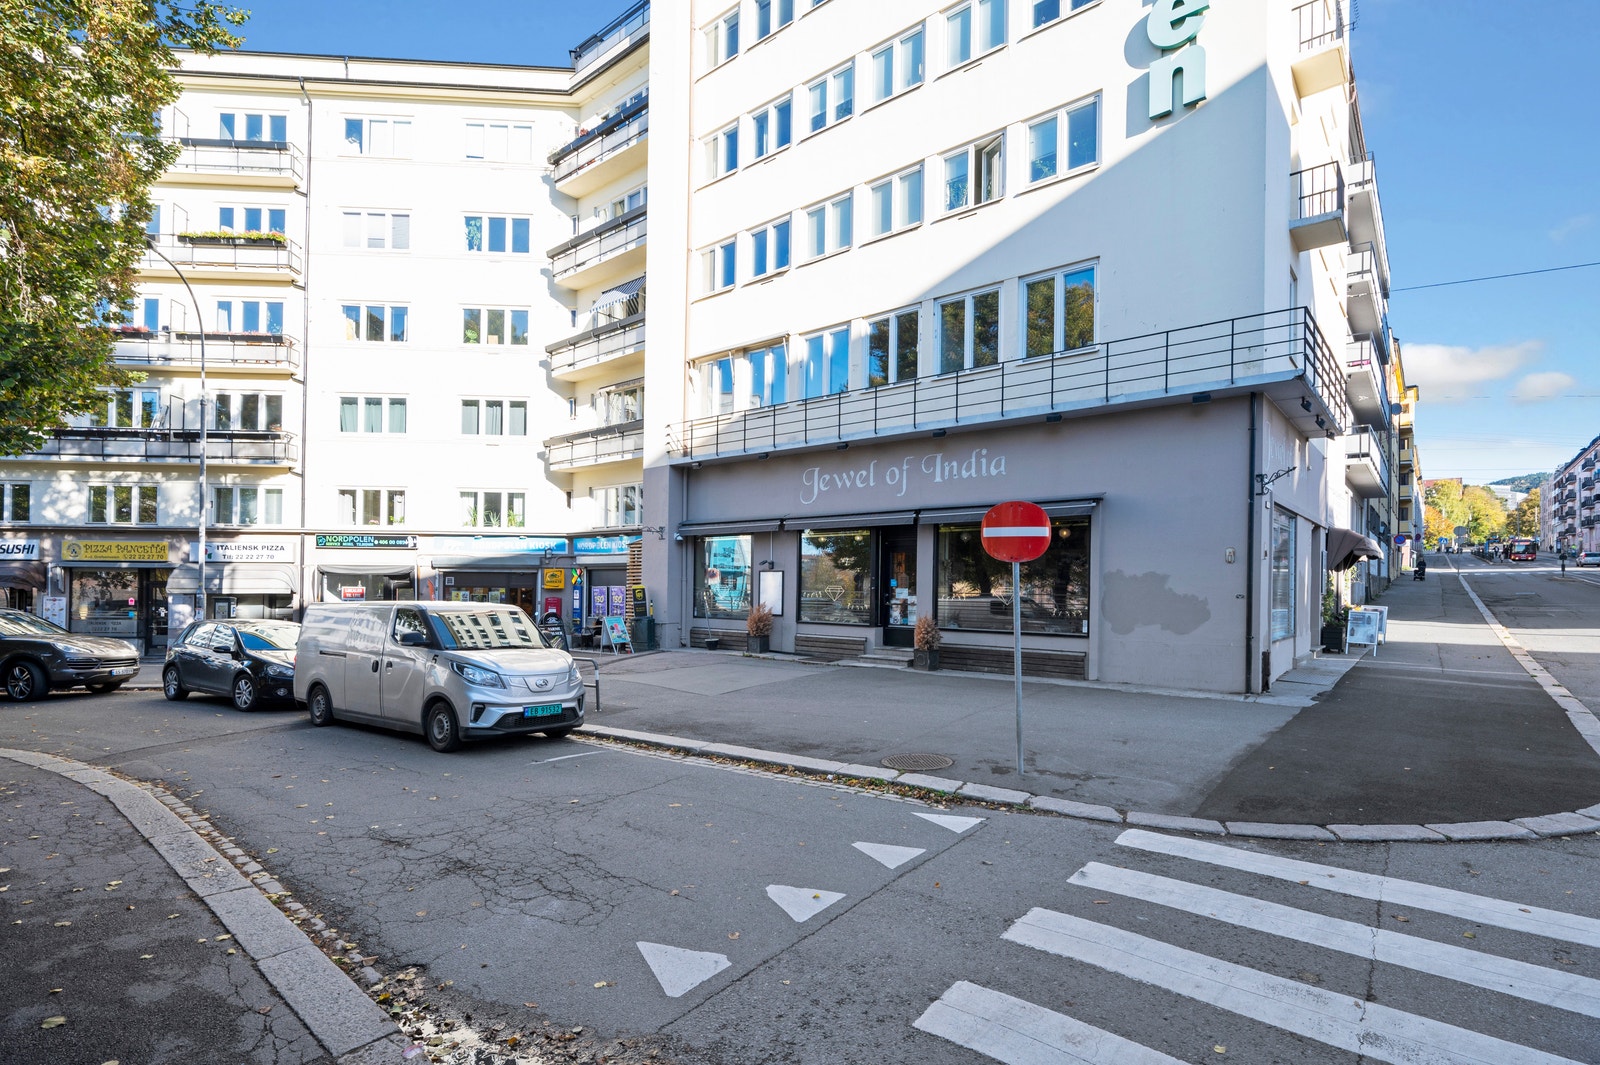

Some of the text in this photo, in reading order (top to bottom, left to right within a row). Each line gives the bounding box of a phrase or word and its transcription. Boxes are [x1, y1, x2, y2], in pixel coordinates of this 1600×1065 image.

[800, 448, 1007, 504] Jewel of India
[325, 535, 375, 543] NORDPOLEN
[0, 544, 35, 555] SUSHI
[83, 543, 112, 554] PIZZA
[115, 543, 166, 554] PANCETTA
[529, 541, 557, 550] KIOSK
[576, 541, 611, 551] NORDPOLEN
[541, 705, 560, 714] 91532
